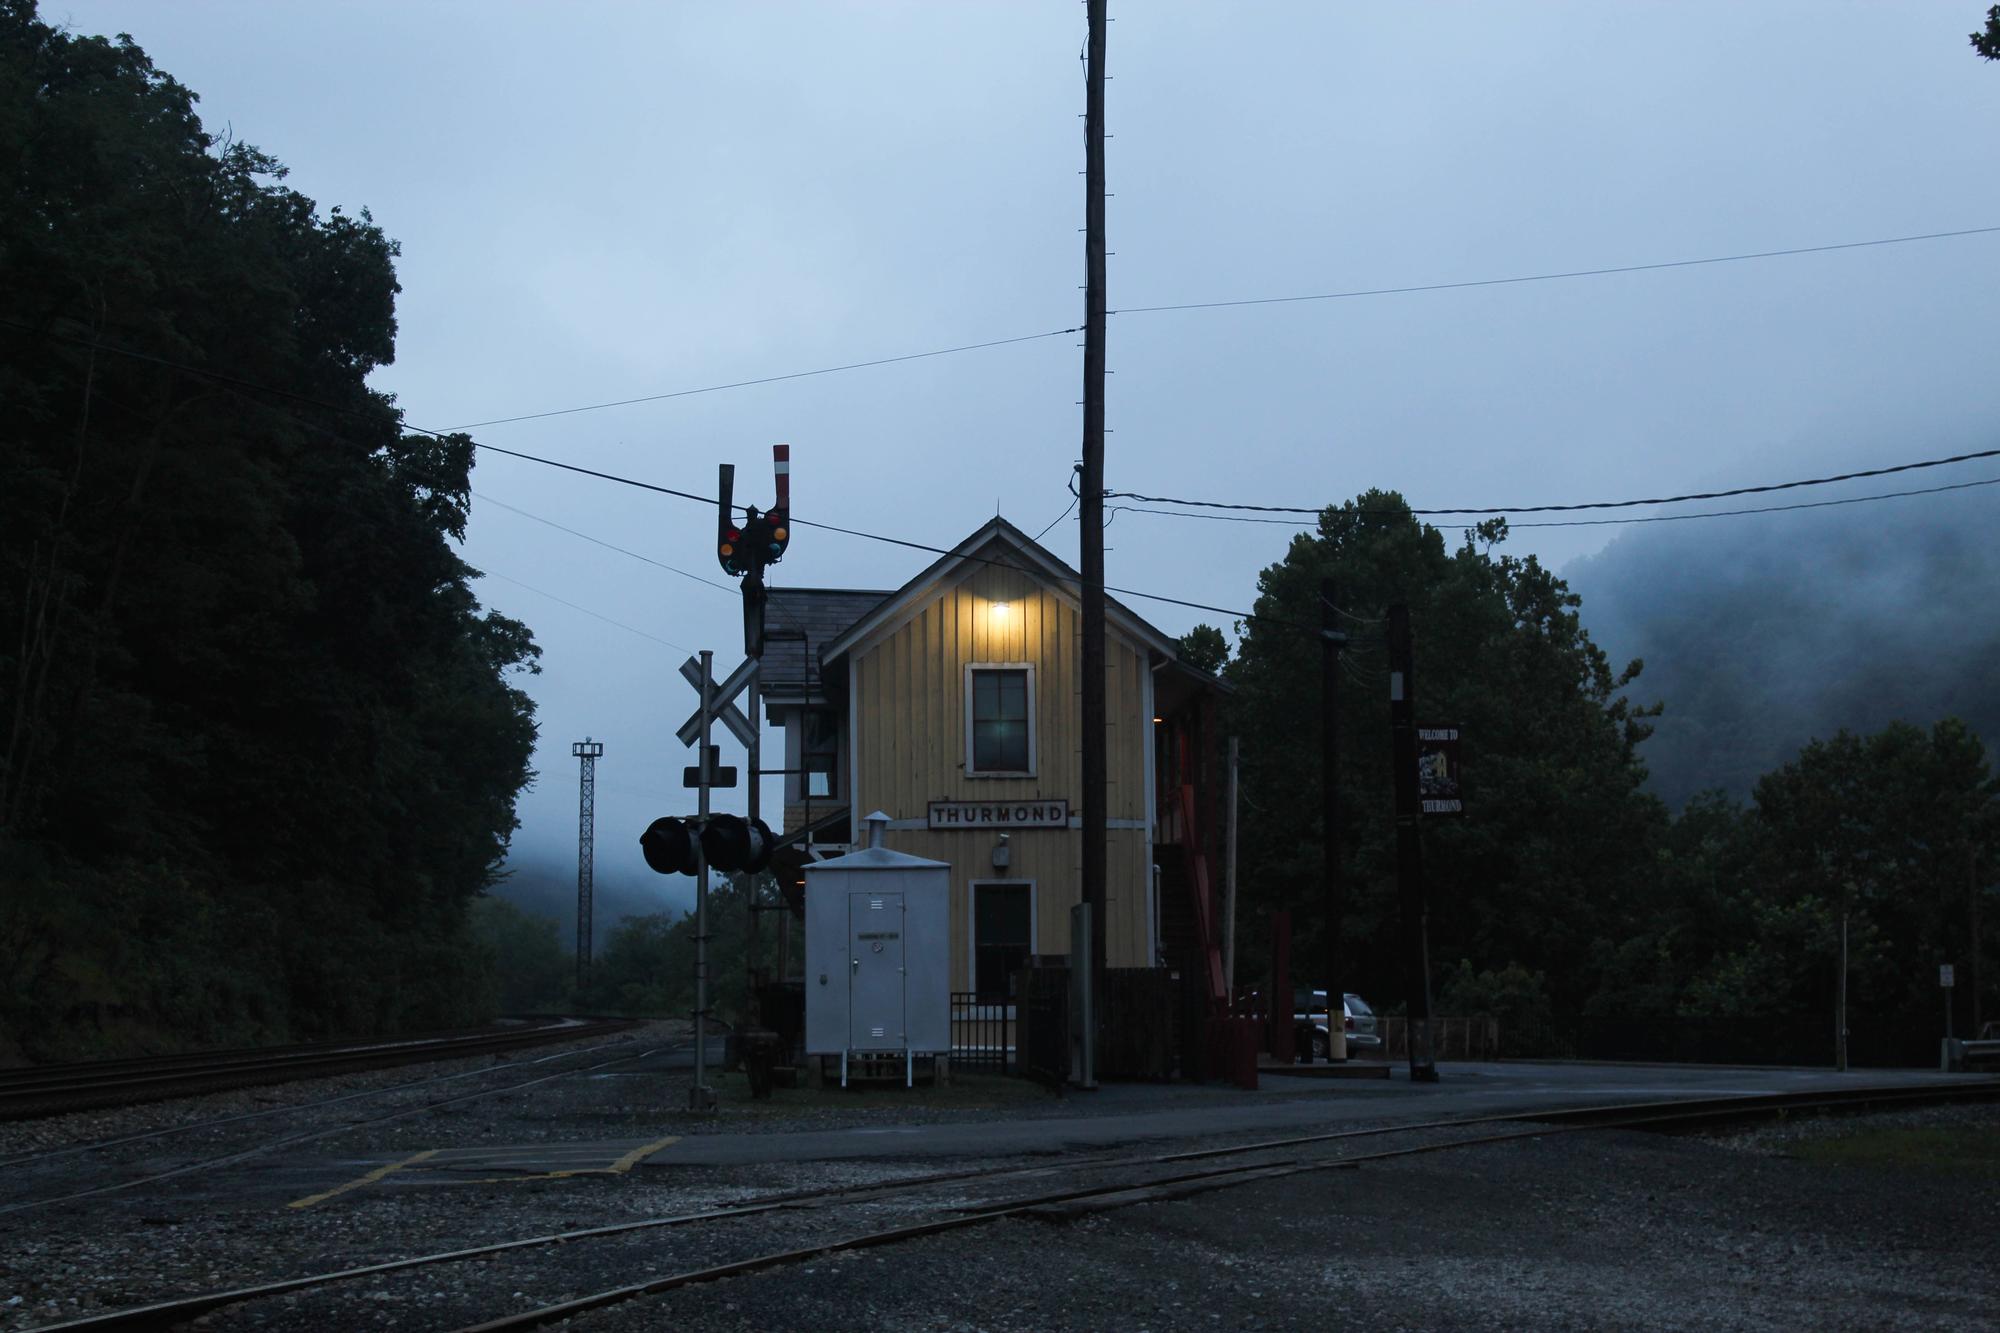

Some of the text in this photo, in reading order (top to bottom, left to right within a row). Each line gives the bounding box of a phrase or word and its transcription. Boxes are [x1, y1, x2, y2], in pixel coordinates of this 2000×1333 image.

[1418, 728, 1458, 740] WELCOME TO
[1421, 799, 1462, 813] THURMOND
[934, 807, 1062, 822] THURMOND
